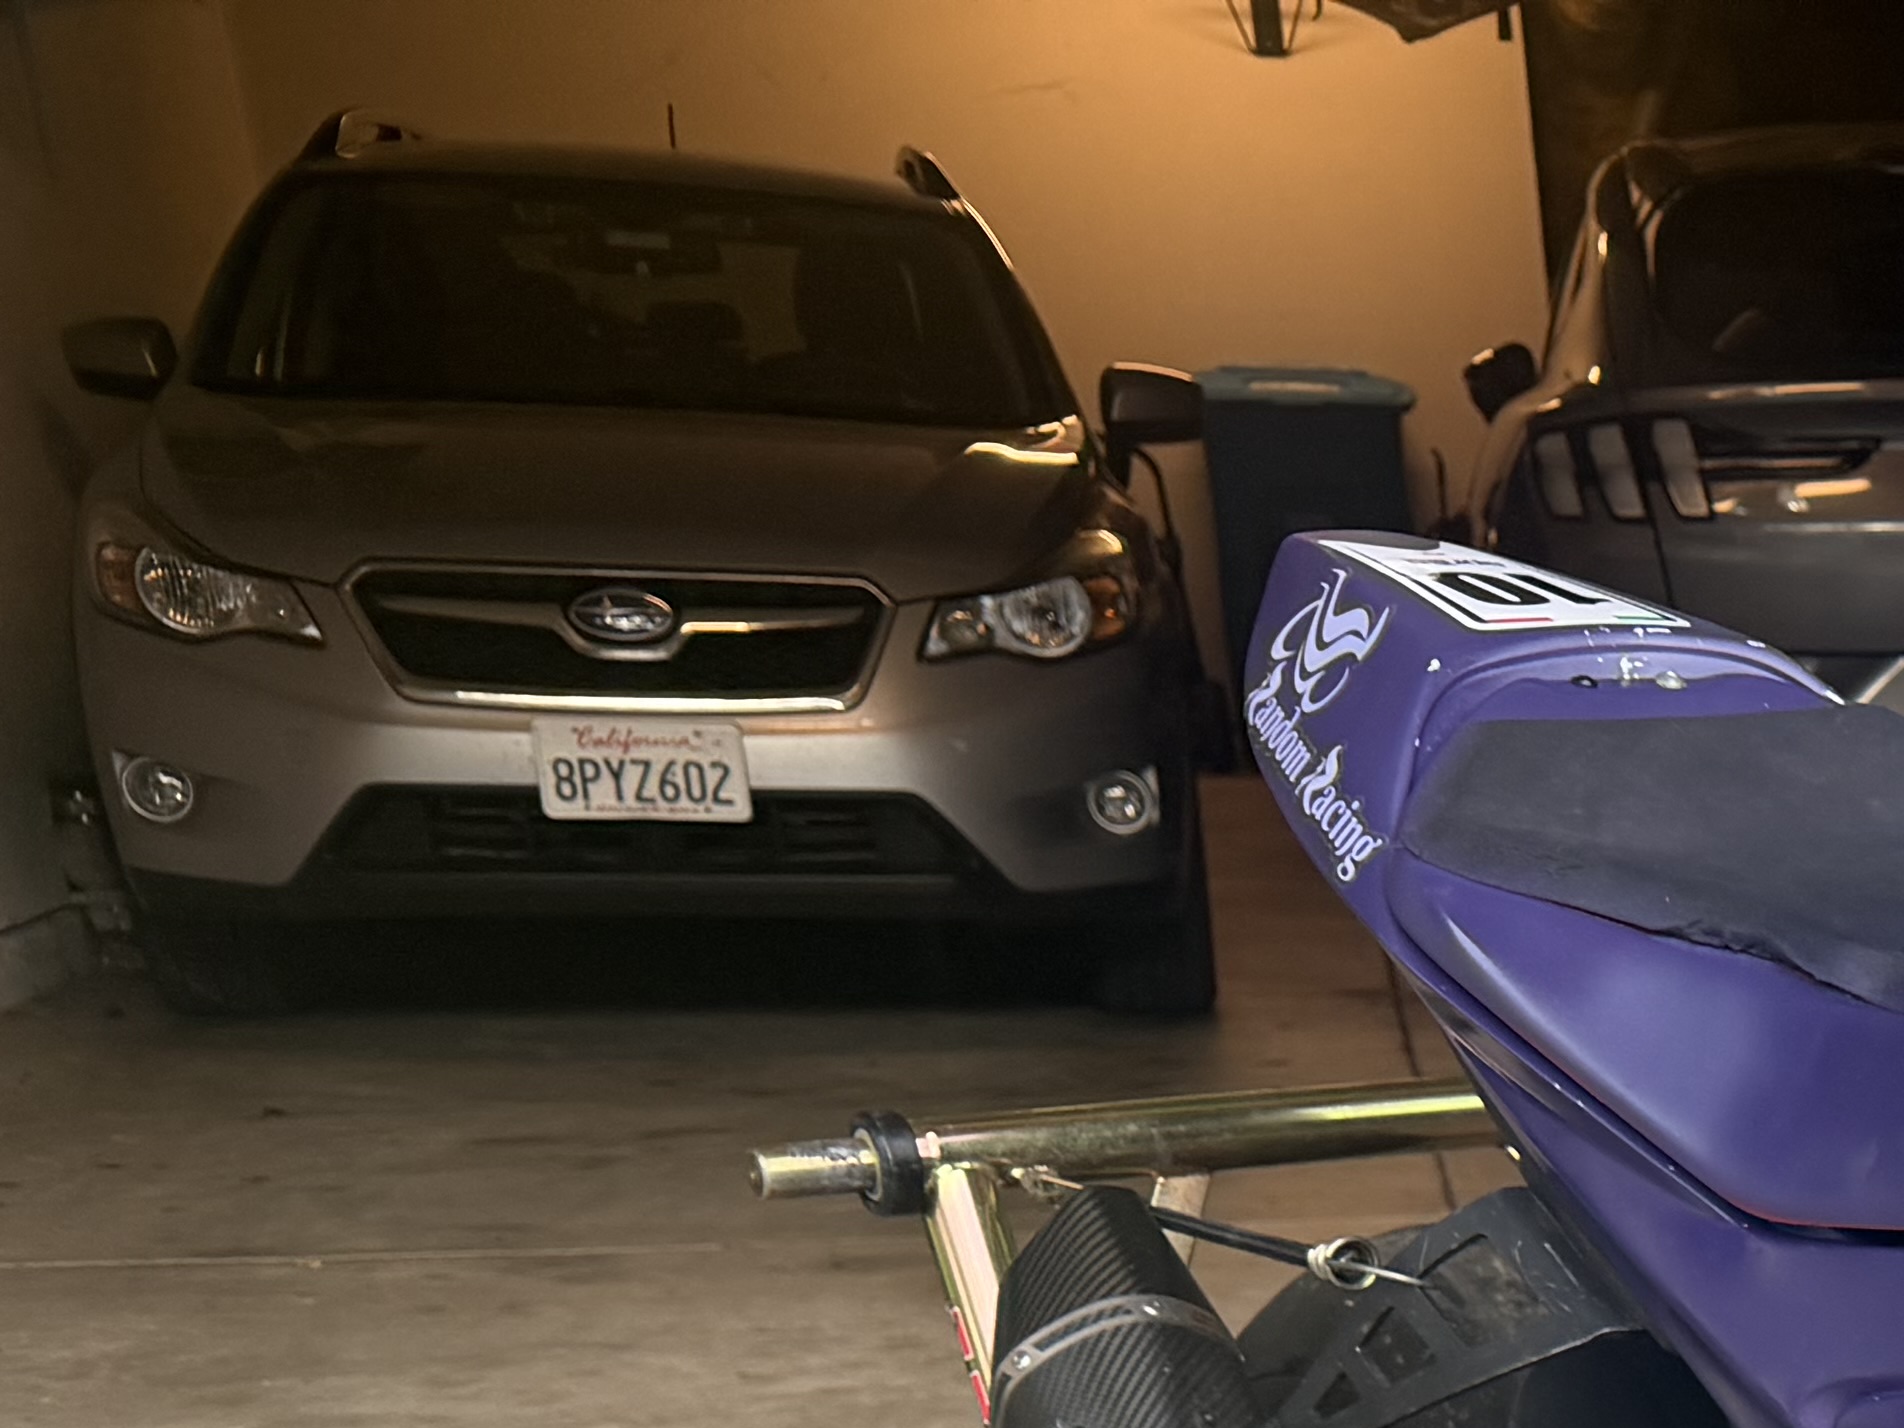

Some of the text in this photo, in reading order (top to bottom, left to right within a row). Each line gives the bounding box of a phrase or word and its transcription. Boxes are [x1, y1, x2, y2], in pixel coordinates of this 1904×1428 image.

[575, 726, 692, 754] California
[552, 757, 735, 806] 8PYZ602
[1245, 661, 1384, 881] Random Racing
